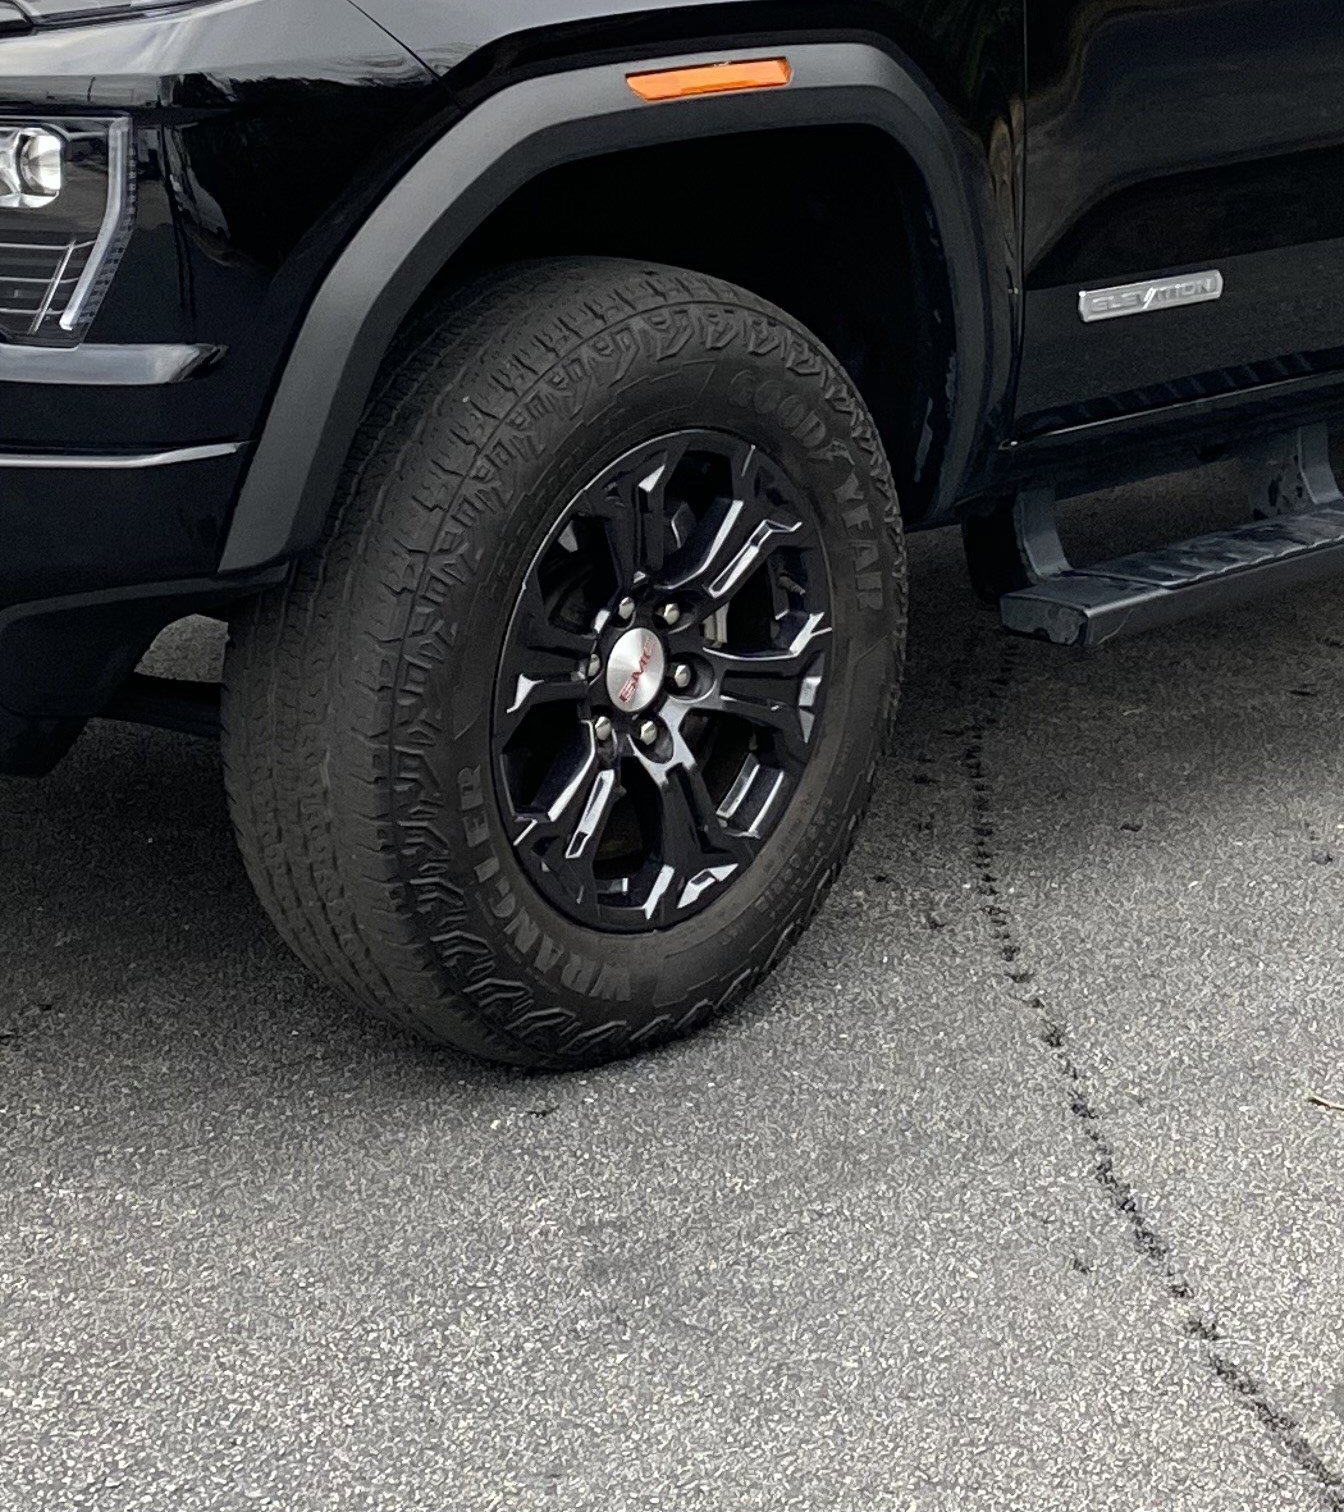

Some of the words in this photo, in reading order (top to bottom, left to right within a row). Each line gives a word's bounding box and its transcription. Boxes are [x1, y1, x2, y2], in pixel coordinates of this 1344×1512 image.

[1091, 277, 1218, 313] ELEVATION
[619, 637, 657, 703] GMC
[457, 763, 632, 1002] WRANGLER
